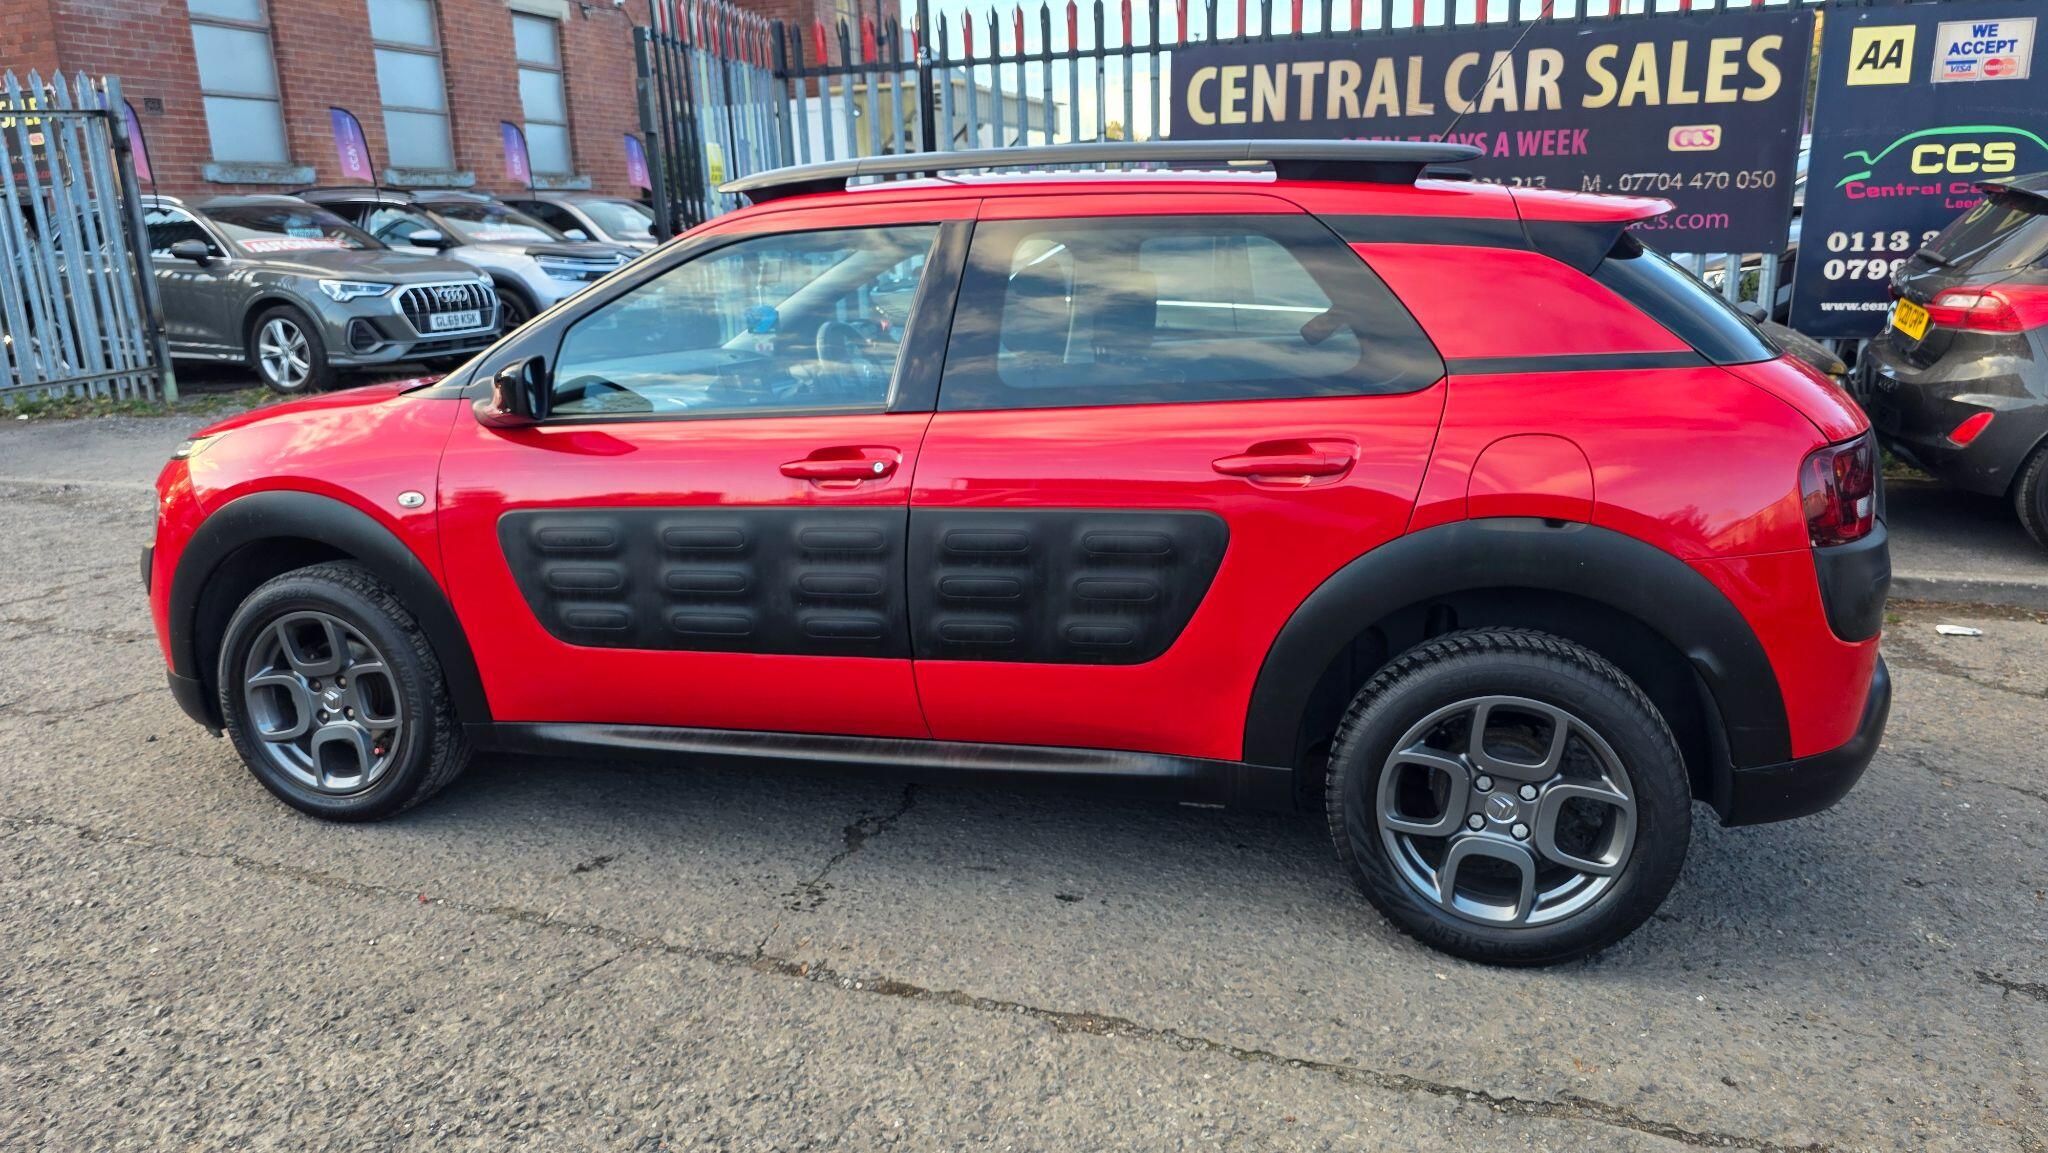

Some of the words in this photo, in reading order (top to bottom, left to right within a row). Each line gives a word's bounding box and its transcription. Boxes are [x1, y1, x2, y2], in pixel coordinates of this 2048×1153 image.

[1972, 24, 1999, 38] WE
[1857, 39, 1904, 70] AA
[1948, 39, 2018, 56] ACCEPT
[1951, 64, 1972, 72] VISA
[1187, 56, 1434, 125] CENTRAL
[1444, 48, 1564, 114] CAR
[1582, 35, 1783, 108] SALES
[1493, 132, 1509, 157] A
[1517, 129, 1589, 156] WEEK
[1674, 129, 1715, 147] CCS
[1911, 141, 2016, 174] CCS
[1619, 173, 1683, 191] 07704
[1688, 171, 1730, 190] 470
[1736, 170, 1777, 189] 050
[1846, 181, 1941, 199] Central
[1827, 230, 1910, 252] 0113
